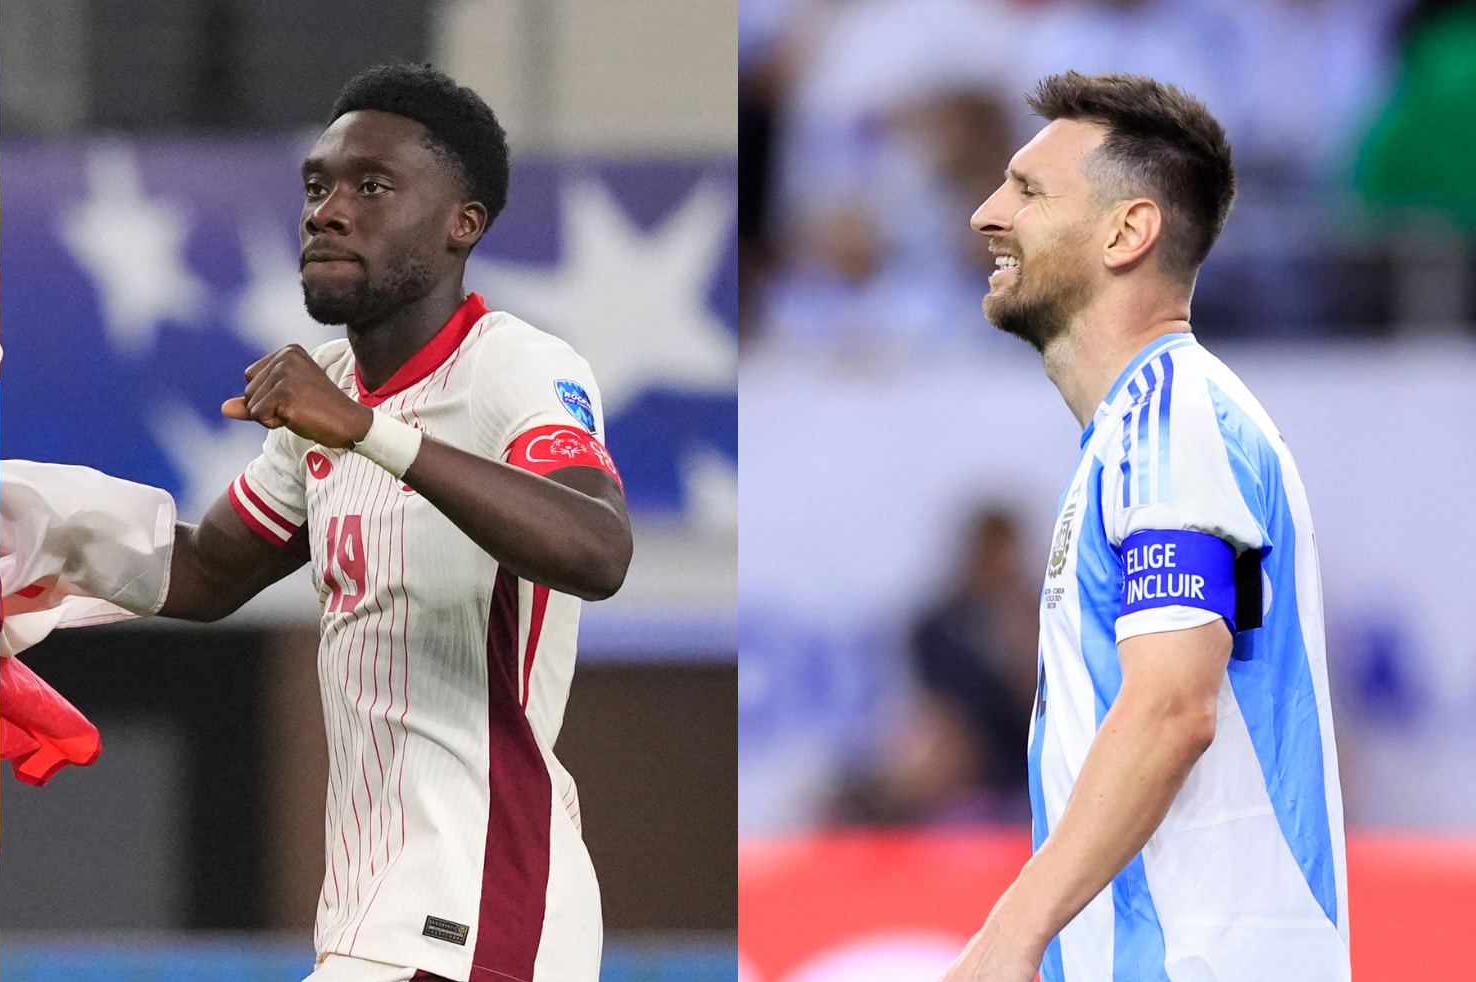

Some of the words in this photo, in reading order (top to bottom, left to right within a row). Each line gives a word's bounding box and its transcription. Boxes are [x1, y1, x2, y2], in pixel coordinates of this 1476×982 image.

[323, 514, 366, 613] 19
[1127, 543, 1177, 575] ELIGE
[1127, 573, 1205, 605] INCLUIR
